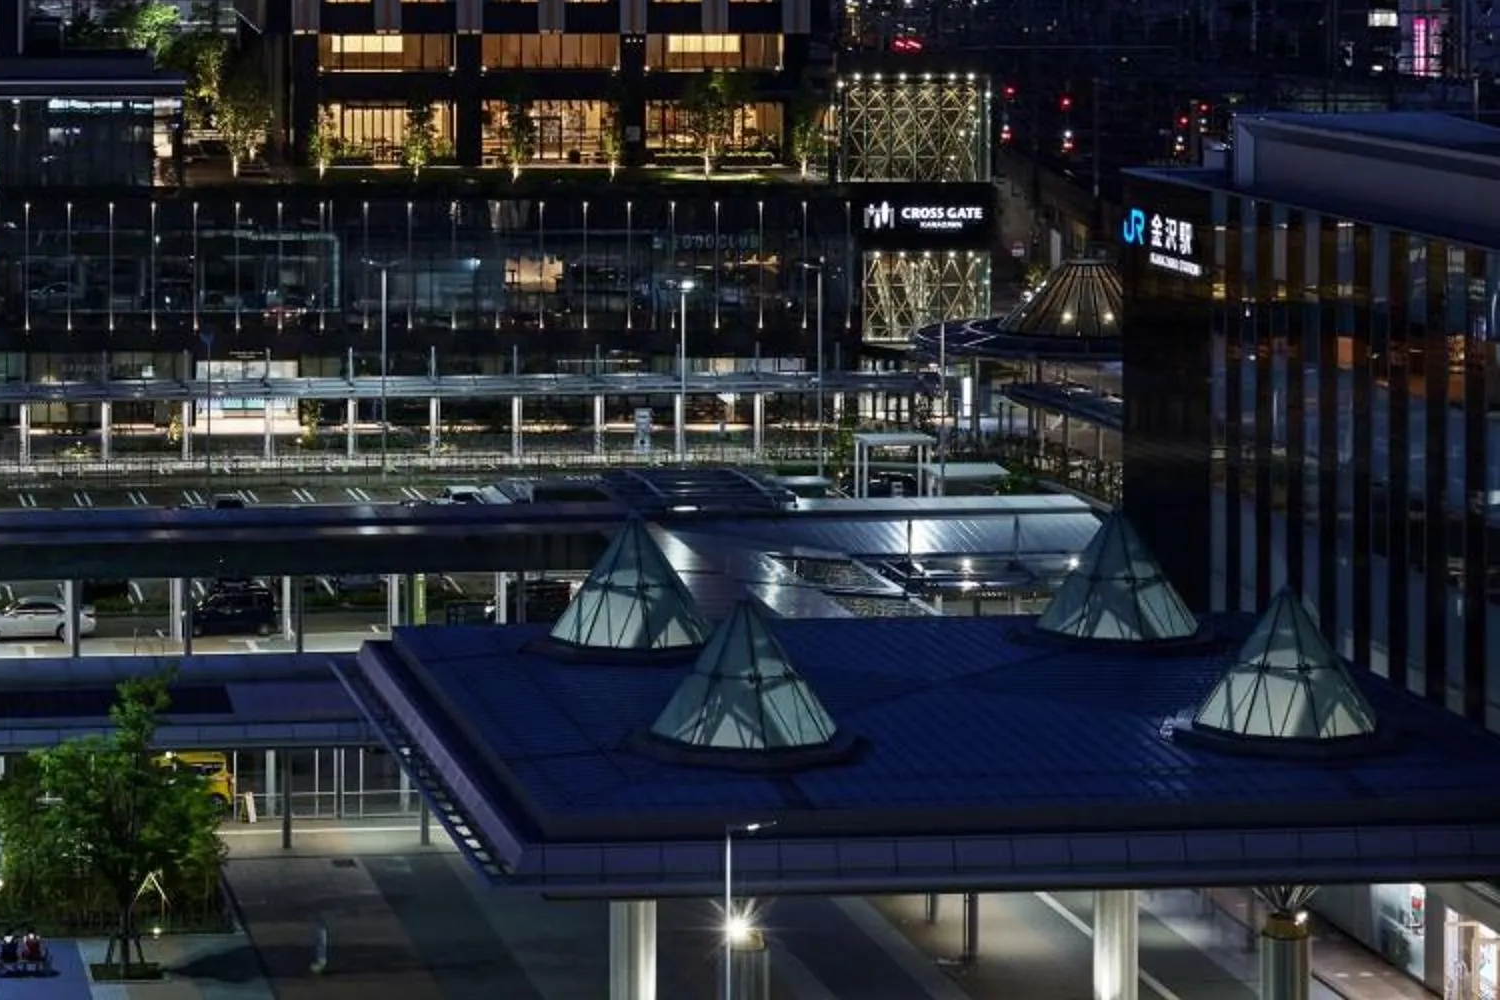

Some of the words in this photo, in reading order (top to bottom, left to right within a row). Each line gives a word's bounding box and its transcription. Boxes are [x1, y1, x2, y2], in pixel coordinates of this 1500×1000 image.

[901, 206, 944, 219] CROSS
[946, 206, 983, 219] GATE
[1123, 208, 1144, 245] JR
[1150, 213, 1193, 255] 金沢駅
